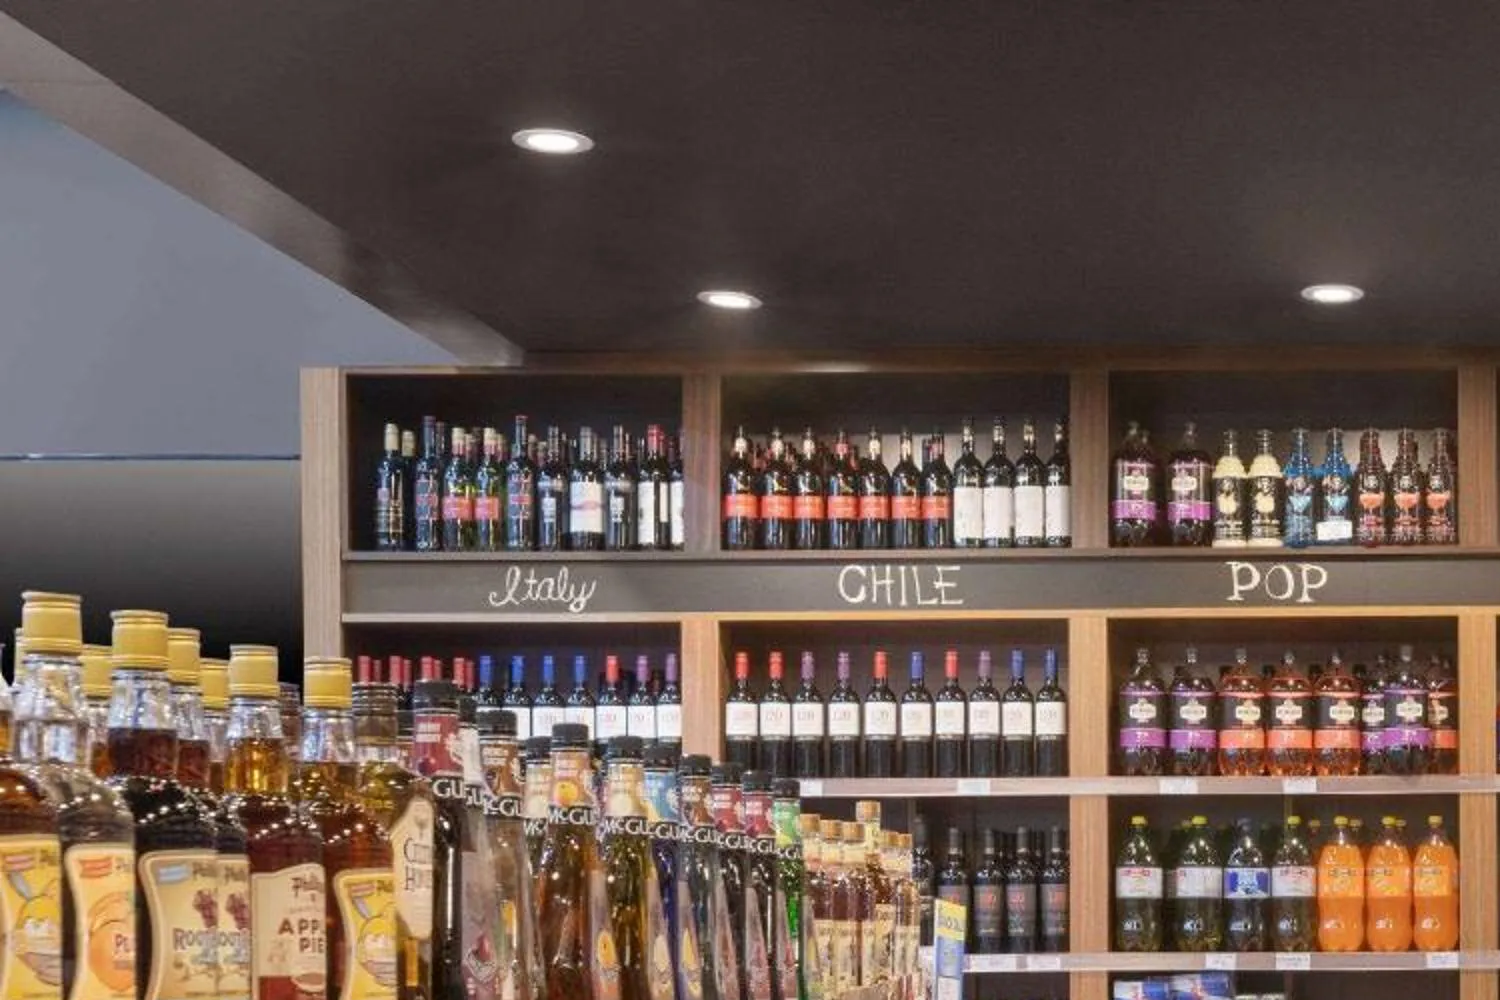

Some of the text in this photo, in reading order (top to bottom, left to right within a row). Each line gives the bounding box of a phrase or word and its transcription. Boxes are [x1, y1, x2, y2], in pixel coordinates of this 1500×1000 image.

[488, 565, 598, 613] Italy
[838, 563, 965, 607] CHILE
[1226, 561, 1329, 602] POP
